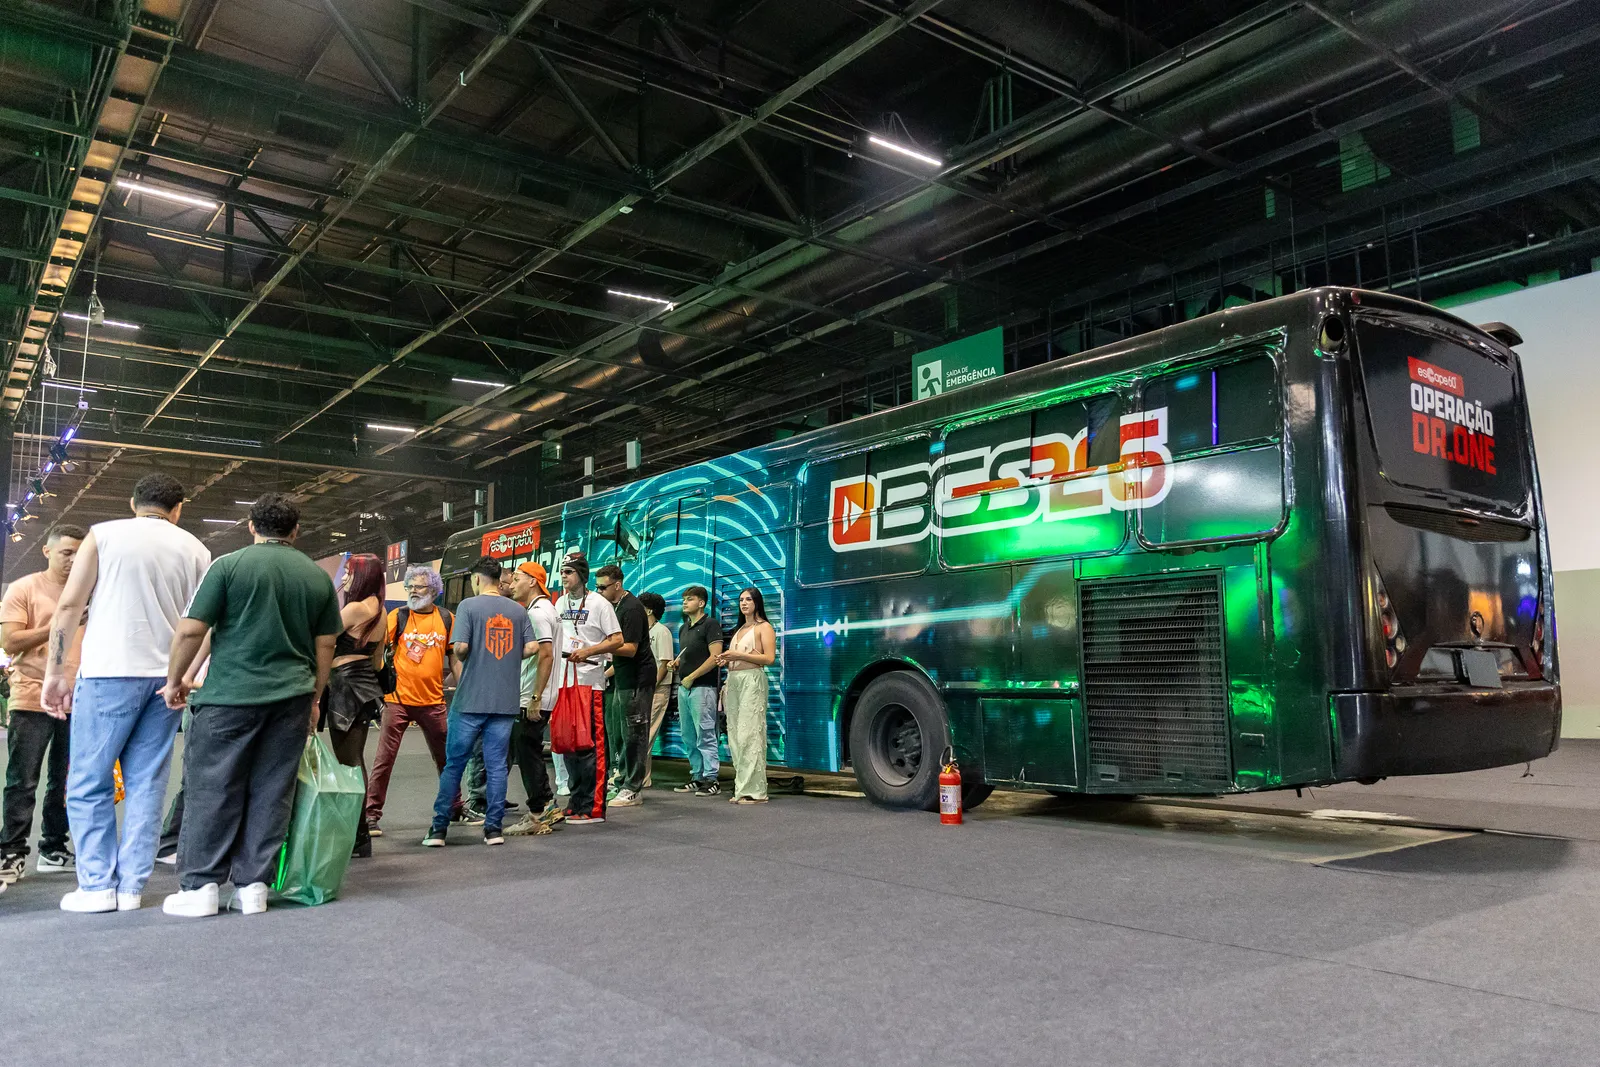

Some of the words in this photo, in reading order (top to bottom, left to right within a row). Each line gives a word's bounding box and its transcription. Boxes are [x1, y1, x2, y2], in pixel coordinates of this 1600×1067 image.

[946, 368, 961, 378] SAÍDA
[946, 366, 996, 388] EMERGÊNCIA
[1410, 382, 1494, 437] OPERAÇÃO
[1412, 411, 1497, 476] DR.ONE
